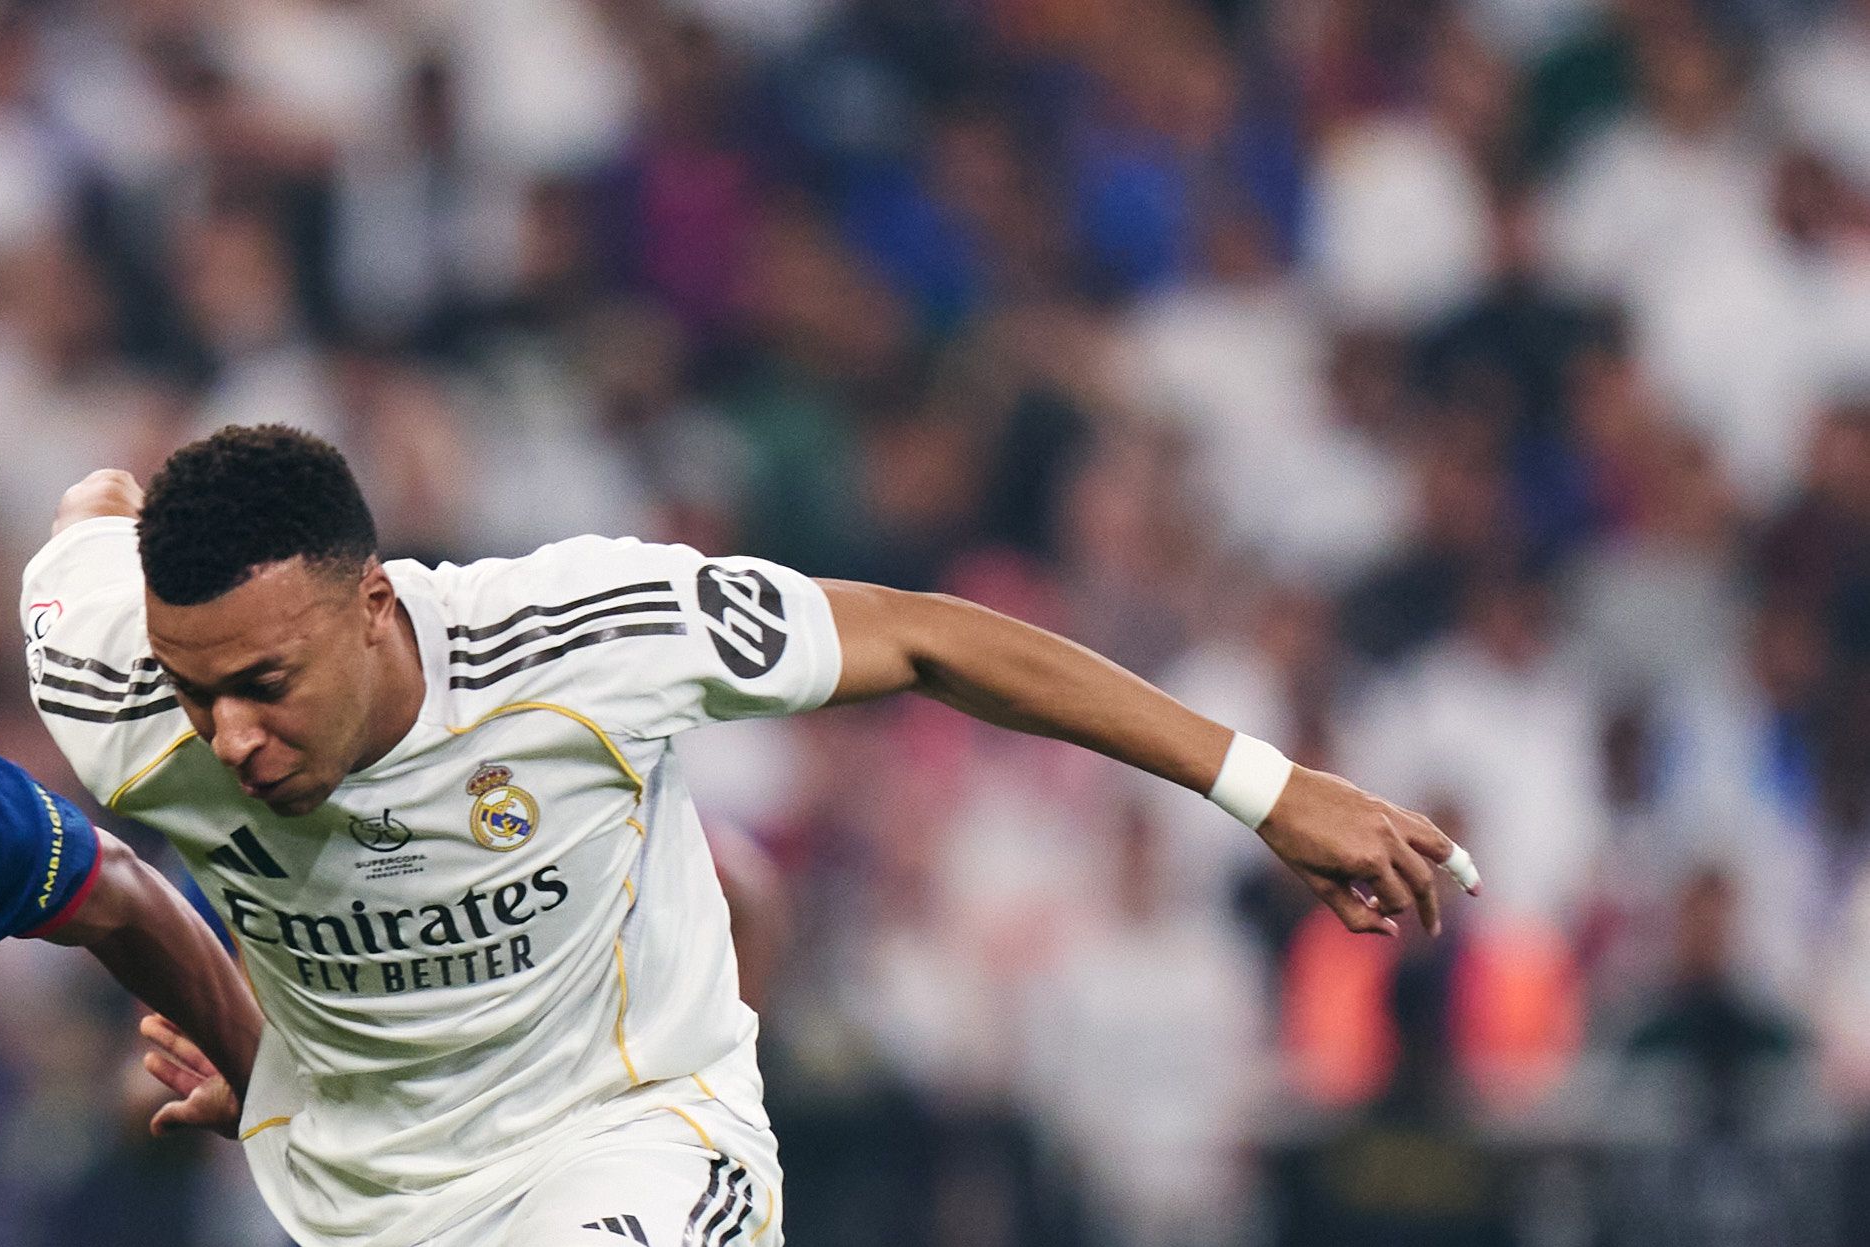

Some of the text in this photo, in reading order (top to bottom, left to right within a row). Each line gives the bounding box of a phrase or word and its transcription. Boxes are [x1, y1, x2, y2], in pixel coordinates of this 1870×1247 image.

[223, 865, 569, 956] Emirates
[296, 933, 537, 995] FLY BETTER
